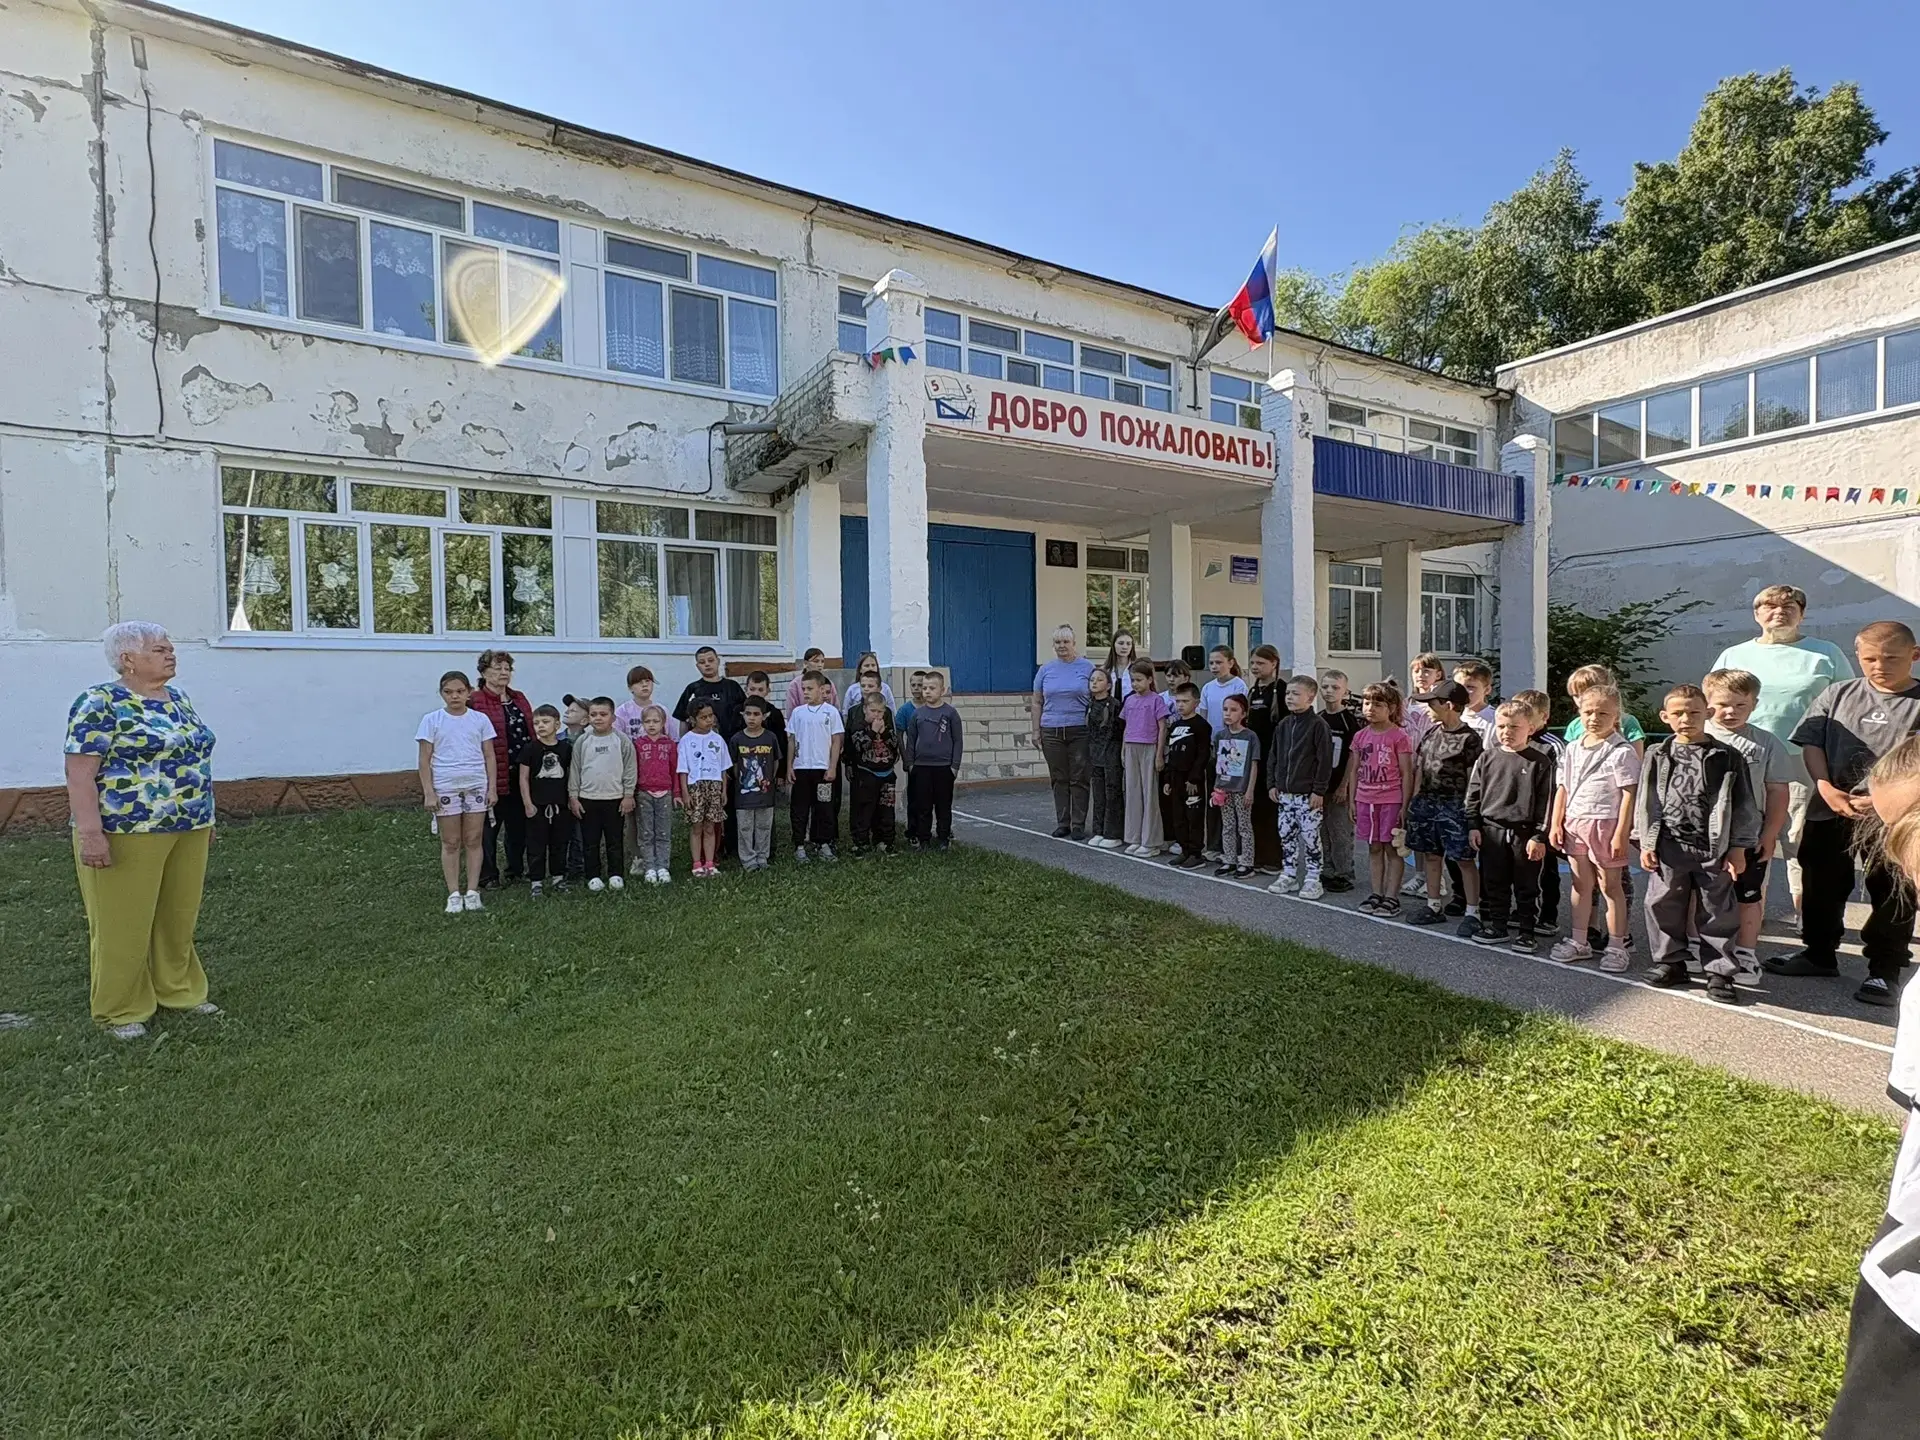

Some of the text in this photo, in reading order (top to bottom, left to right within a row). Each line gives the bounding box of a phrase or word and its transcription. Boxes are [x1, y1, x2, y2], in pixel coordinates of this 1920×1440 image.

[931, 380, 939, 392] 5
[965, 384, 972, 394] 5
[988, 391, 1273, 469] ДОБРО ПОЖАЛОВАТЬ!
